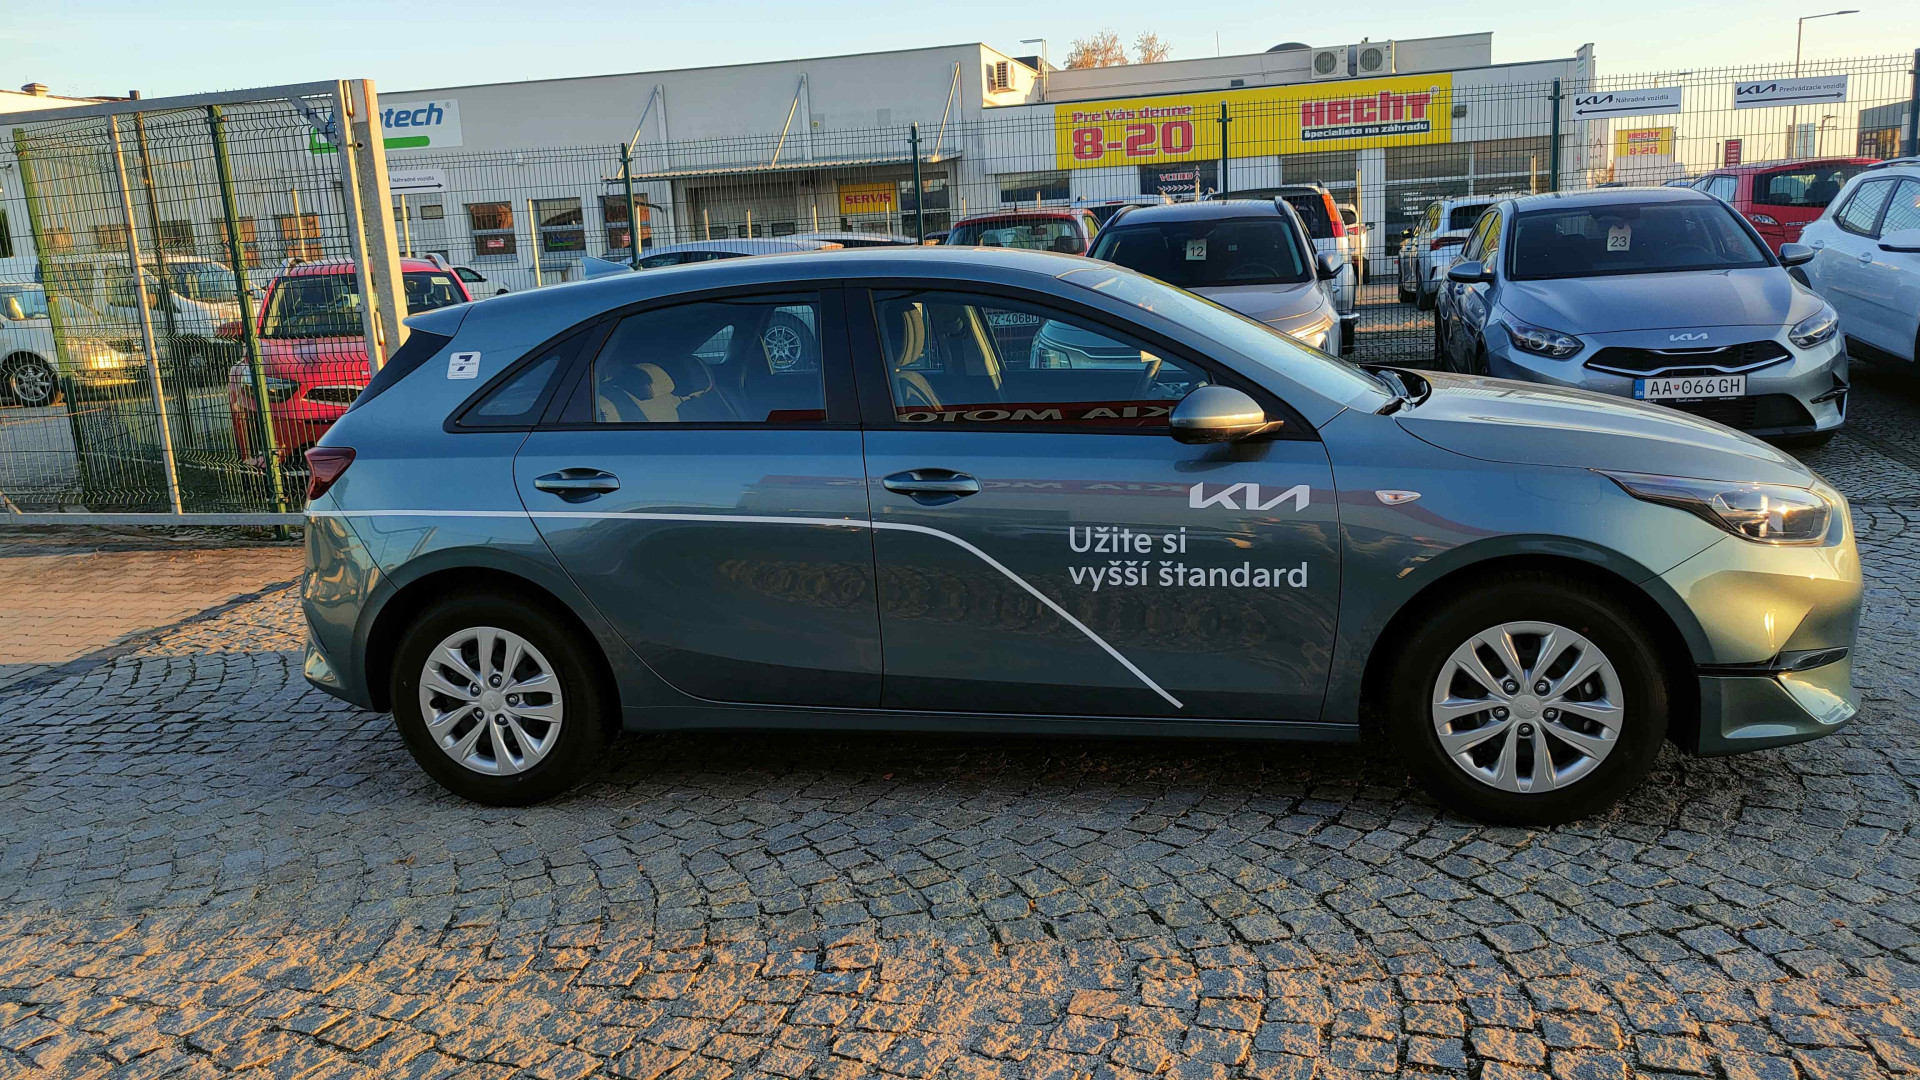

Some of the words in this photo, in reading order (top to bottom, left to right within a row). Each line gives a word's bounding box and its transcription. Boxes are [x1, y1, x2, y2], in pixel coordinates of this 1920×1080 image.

[1823, 82, 1846, 90] vozidlá
[1615, 95, 1646, 104] Náhradné
[1647, 94, 1669, 102] vozidlá
[1073, 111, 1102, 123] Pre
[1104, 108, 1136, 121] Vás
[1139, 105, 1192, 119] denne
[1381, 121, 1428, 134] záhradu
[1072, 120, 1194, 160] 8-20
[845, 192, 891, 205] SERVIS
[1610, 235, 1627, 248] 23
[1190, 246, 1204, 257] 12
[1189, 482, 1311, 512] KIA
[1069, 526, 1153, 554] Užite
[1163, 526, 1187, 554] si
[1068, 560, 1149, 592] vyšší
[1159, 561, 1308, 588] štandard
